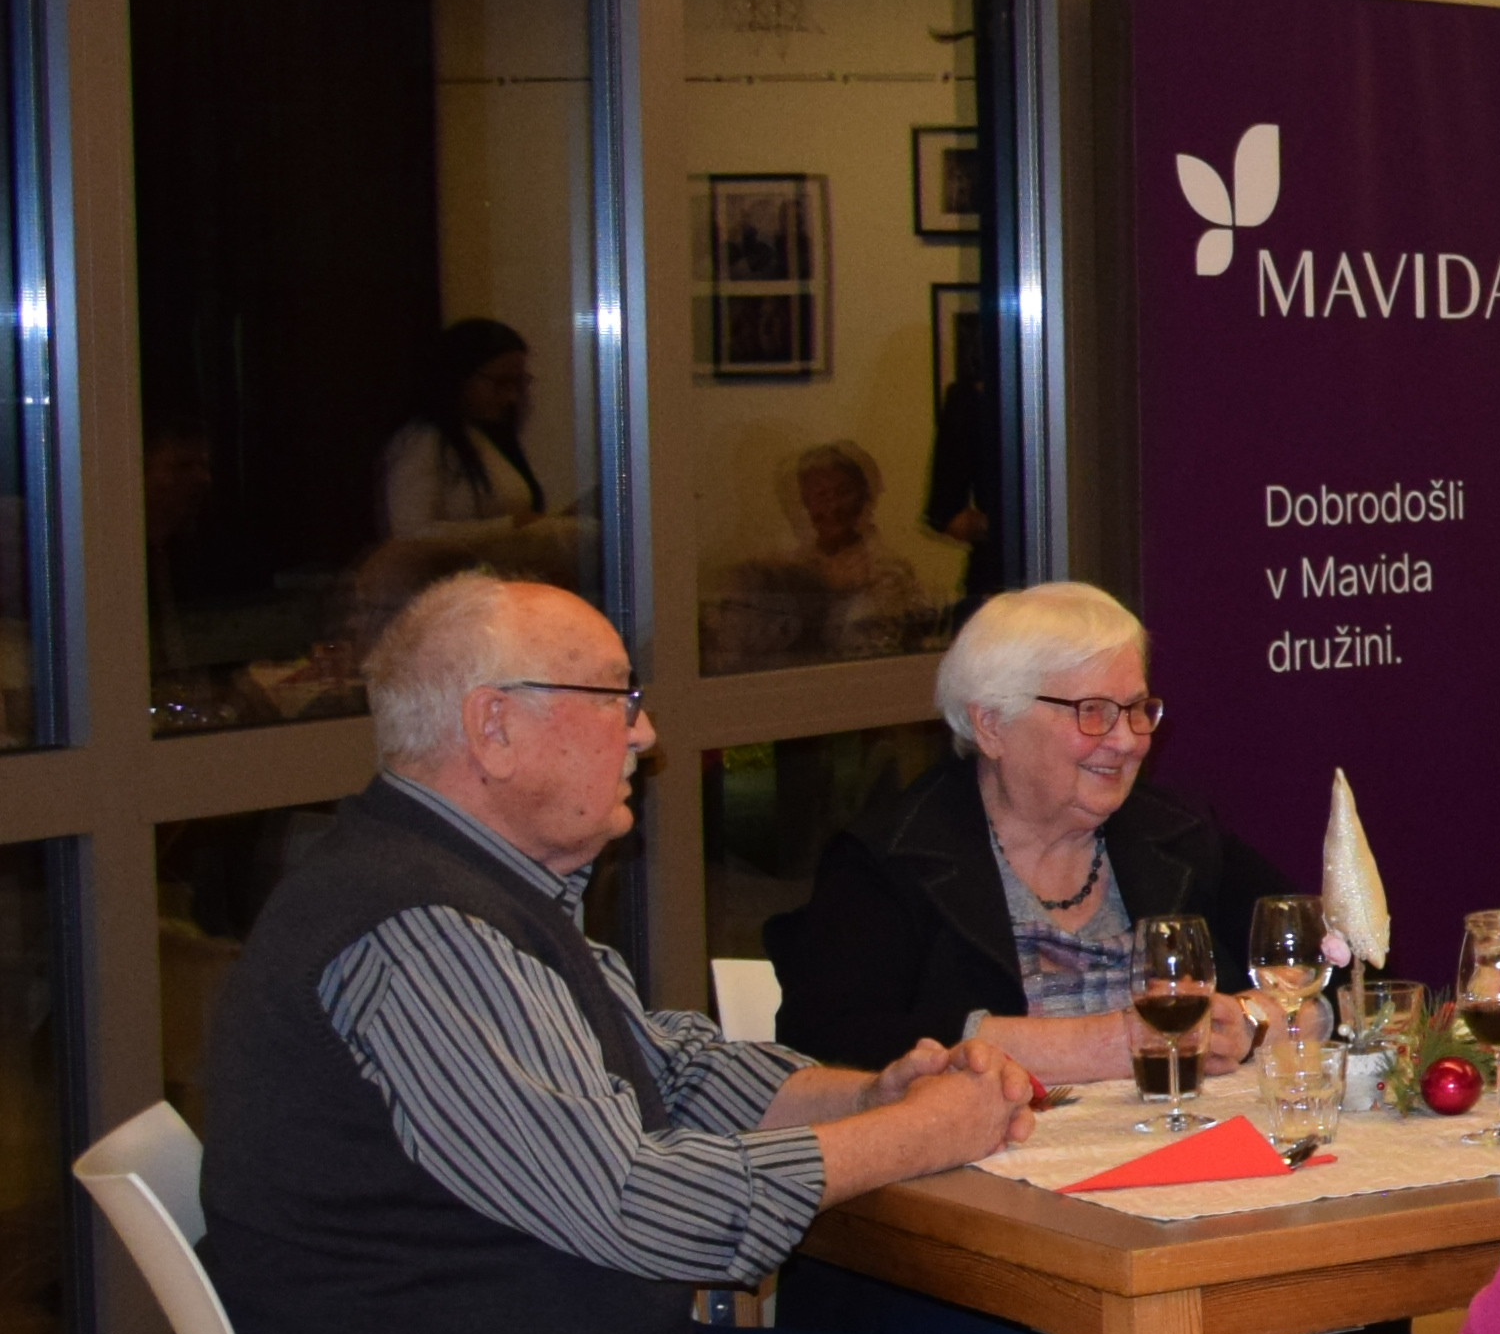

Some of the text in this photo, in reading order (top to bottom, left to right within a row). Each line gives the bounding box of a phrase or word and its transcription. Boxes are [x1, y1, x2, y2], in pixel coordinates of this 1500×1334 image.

[1265, 478, 1465, 528] Dobrodošli
[1265, 552, 1433, 600] v Mavida
[1267, 623, 1403, 673] družini.
